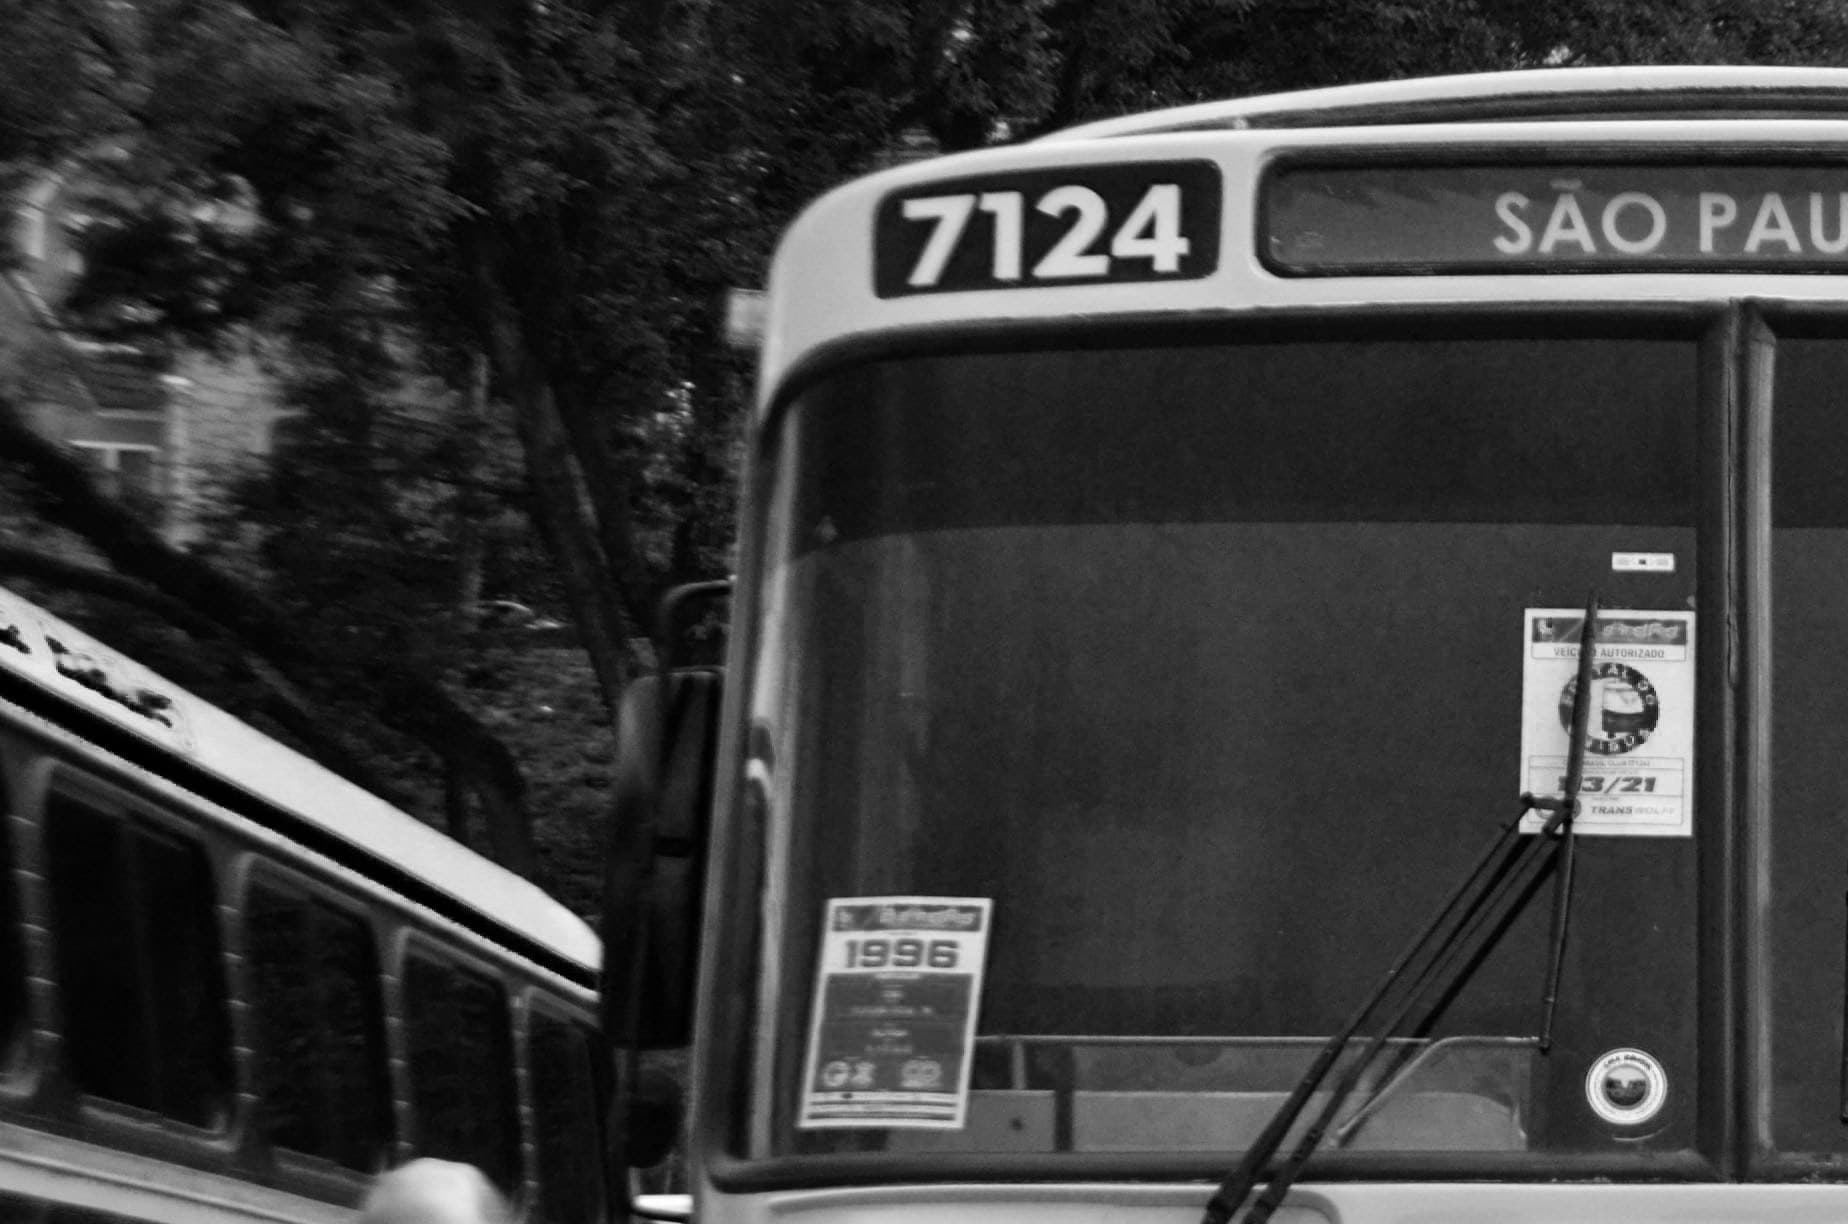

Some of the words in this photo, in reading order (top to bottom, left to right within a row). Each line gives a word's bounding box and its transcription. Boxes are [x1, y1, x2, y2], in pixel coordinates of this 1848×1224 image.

[901, 184, 1190, 287] 7124
[1493, 179, 1668, 254] SÃO
[1600, 648, 1665, 659] AUTORIZADO
[845, 938, 959, 969] 1996
